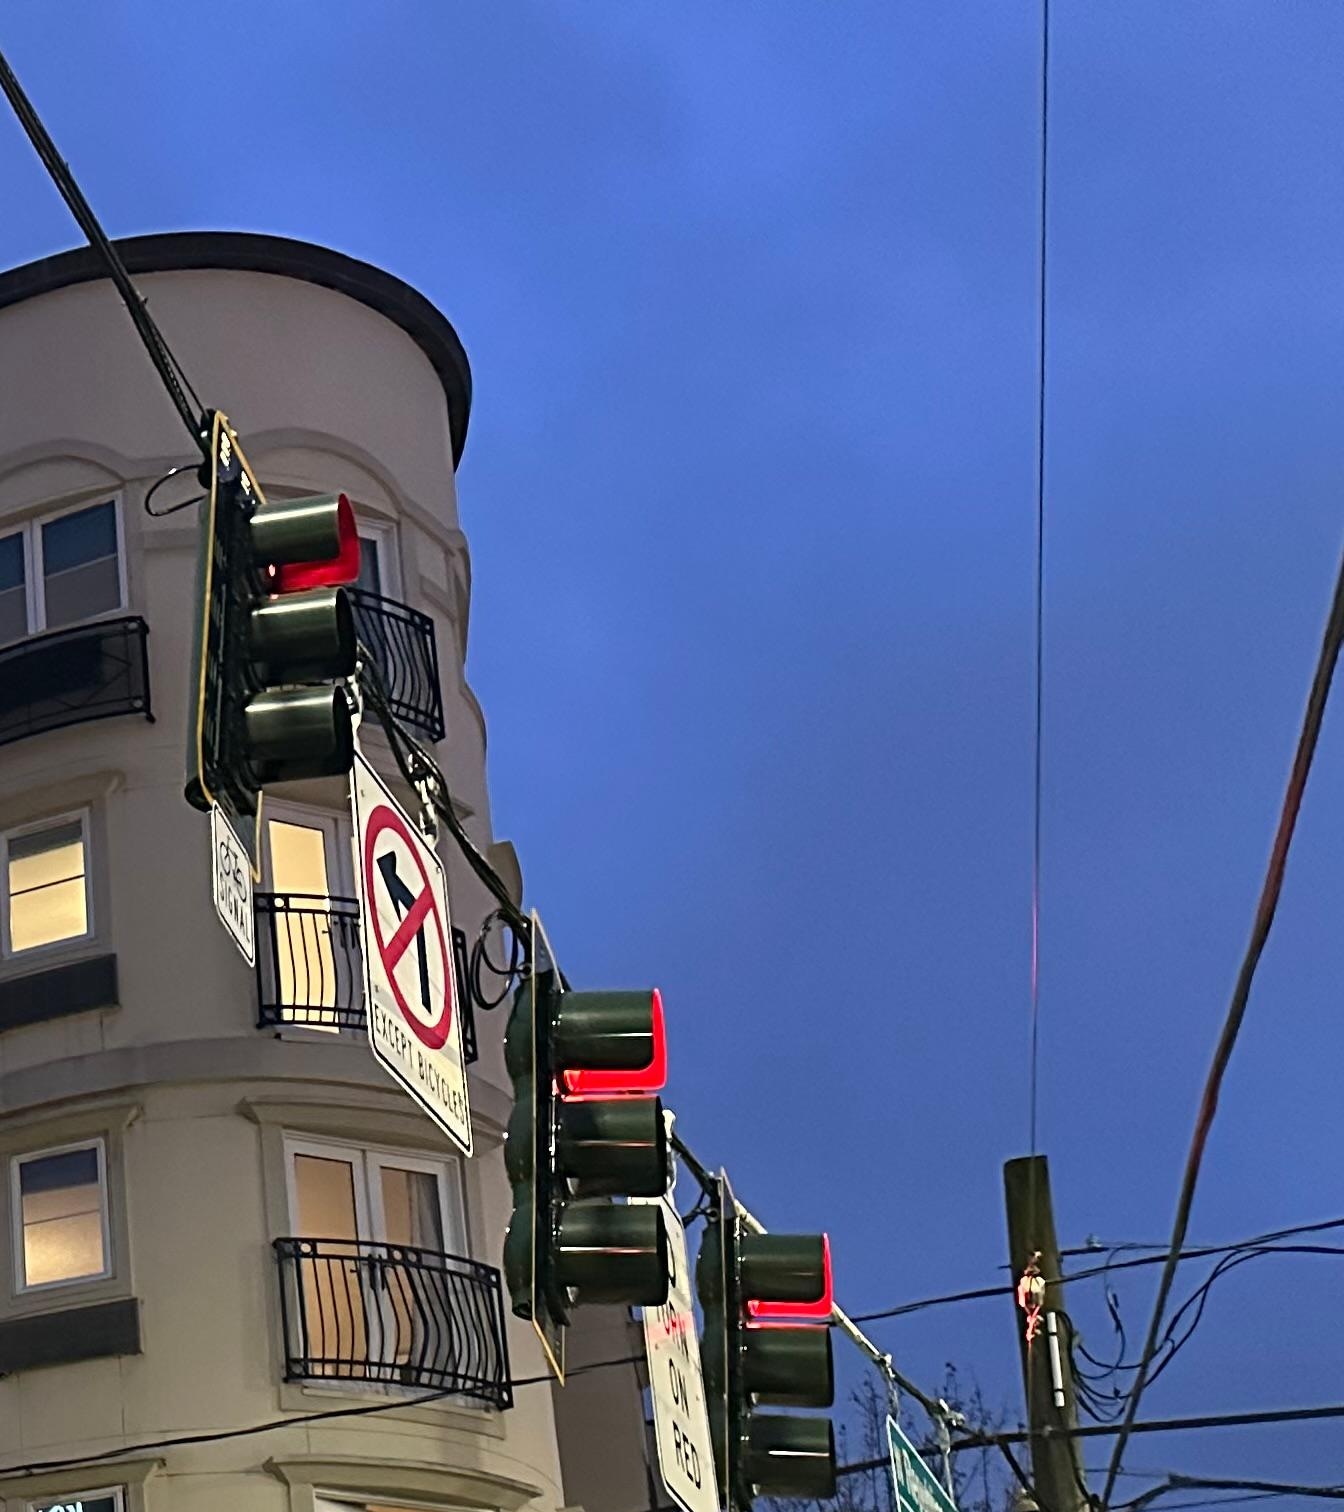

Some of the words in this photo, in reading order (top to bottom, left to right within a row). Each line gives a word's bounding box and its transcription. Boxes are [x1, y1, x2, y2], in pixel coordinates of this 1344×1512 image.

[219, 872, 250, 944] SIGNAL
[374, 1004, 414, 1070] EXCEPT
[418, 1052, 465, 1126] BICYCLES
[668, 1358, 690, 1419] ON
[672, 1420, 702, 1490] RED
